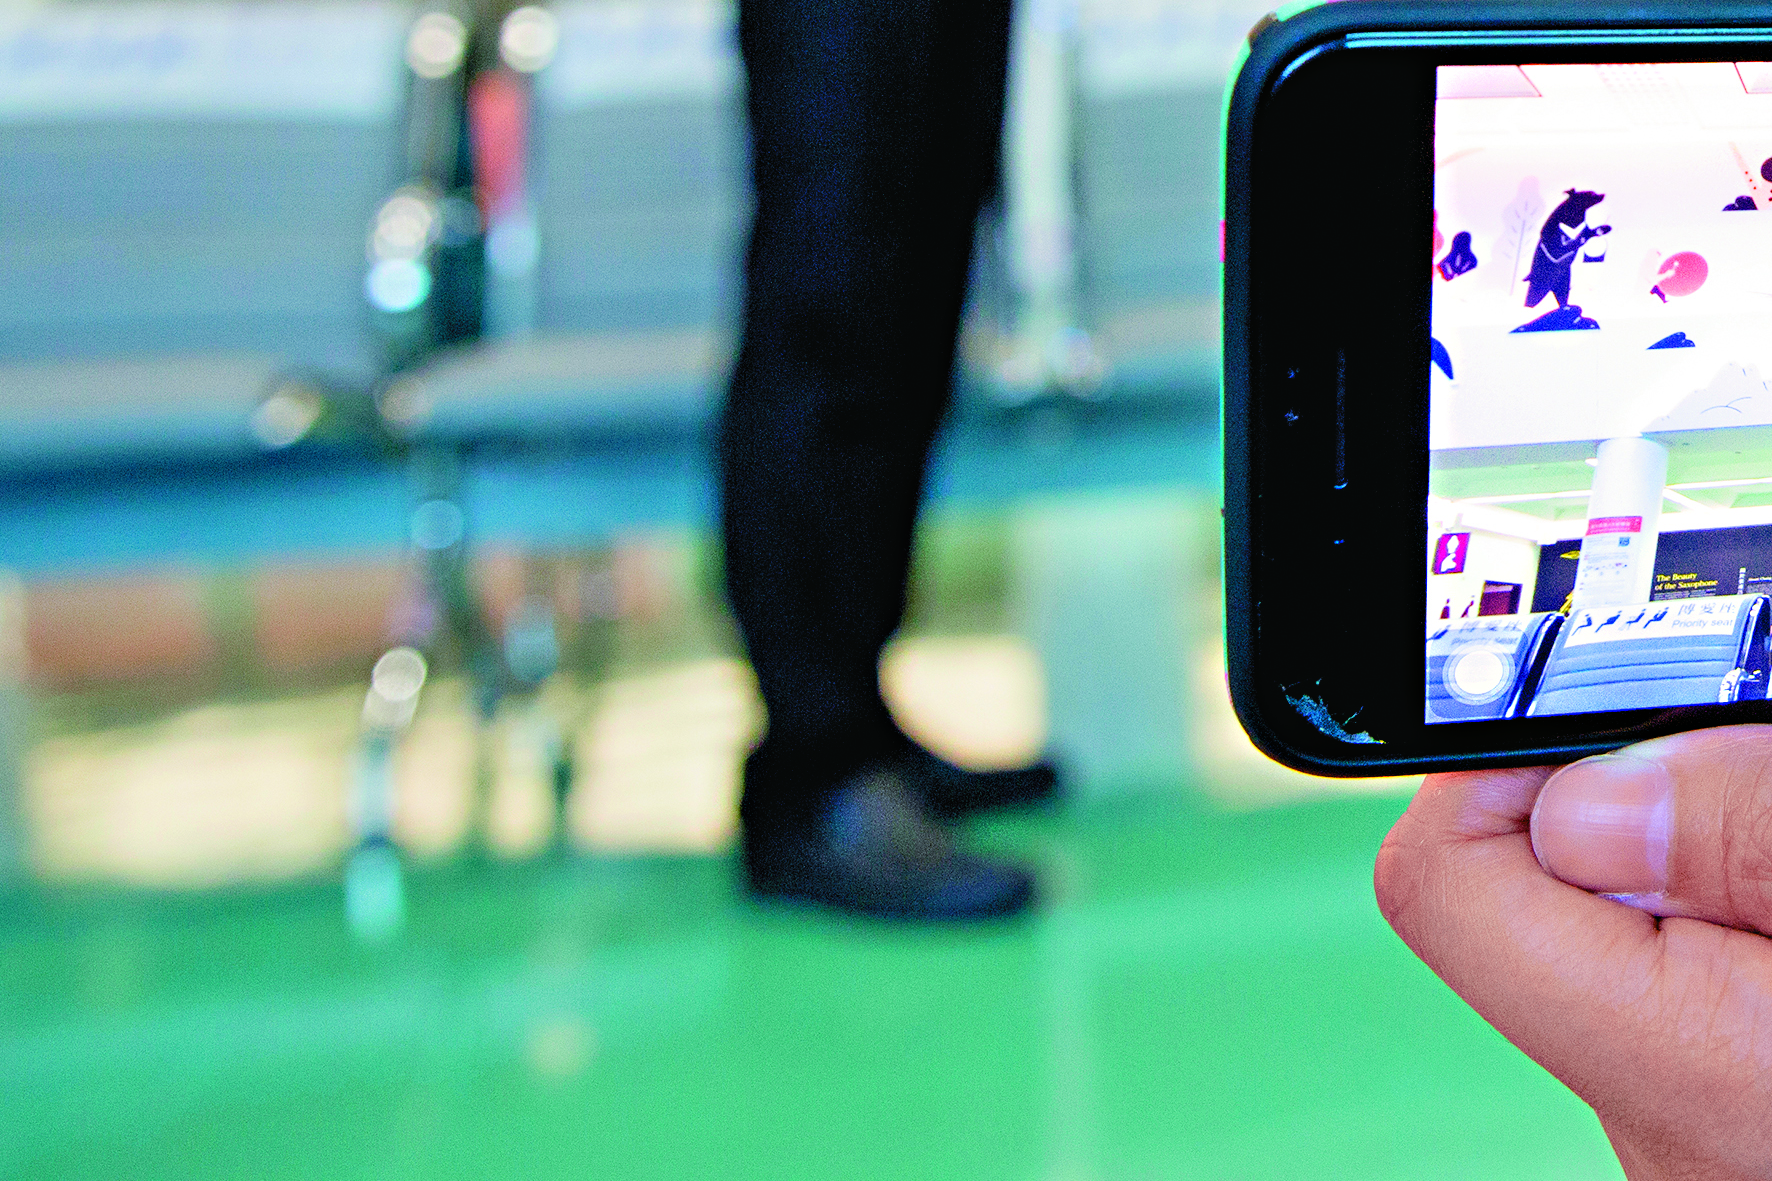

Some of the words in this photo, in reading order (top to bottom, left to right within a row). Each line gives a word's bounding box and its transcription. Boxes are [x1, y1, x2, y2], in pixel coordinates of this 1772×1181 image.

[1656, 574, 1670, 582] The
[1672, 573, 1697, 581] Beauty
[1664, 582, 1676, 590] the
[1678, 580, 1718, 589] Saxophone
[1672, 619, 1708, 629] Priority
[1711, 619, 1733, 627] seat
